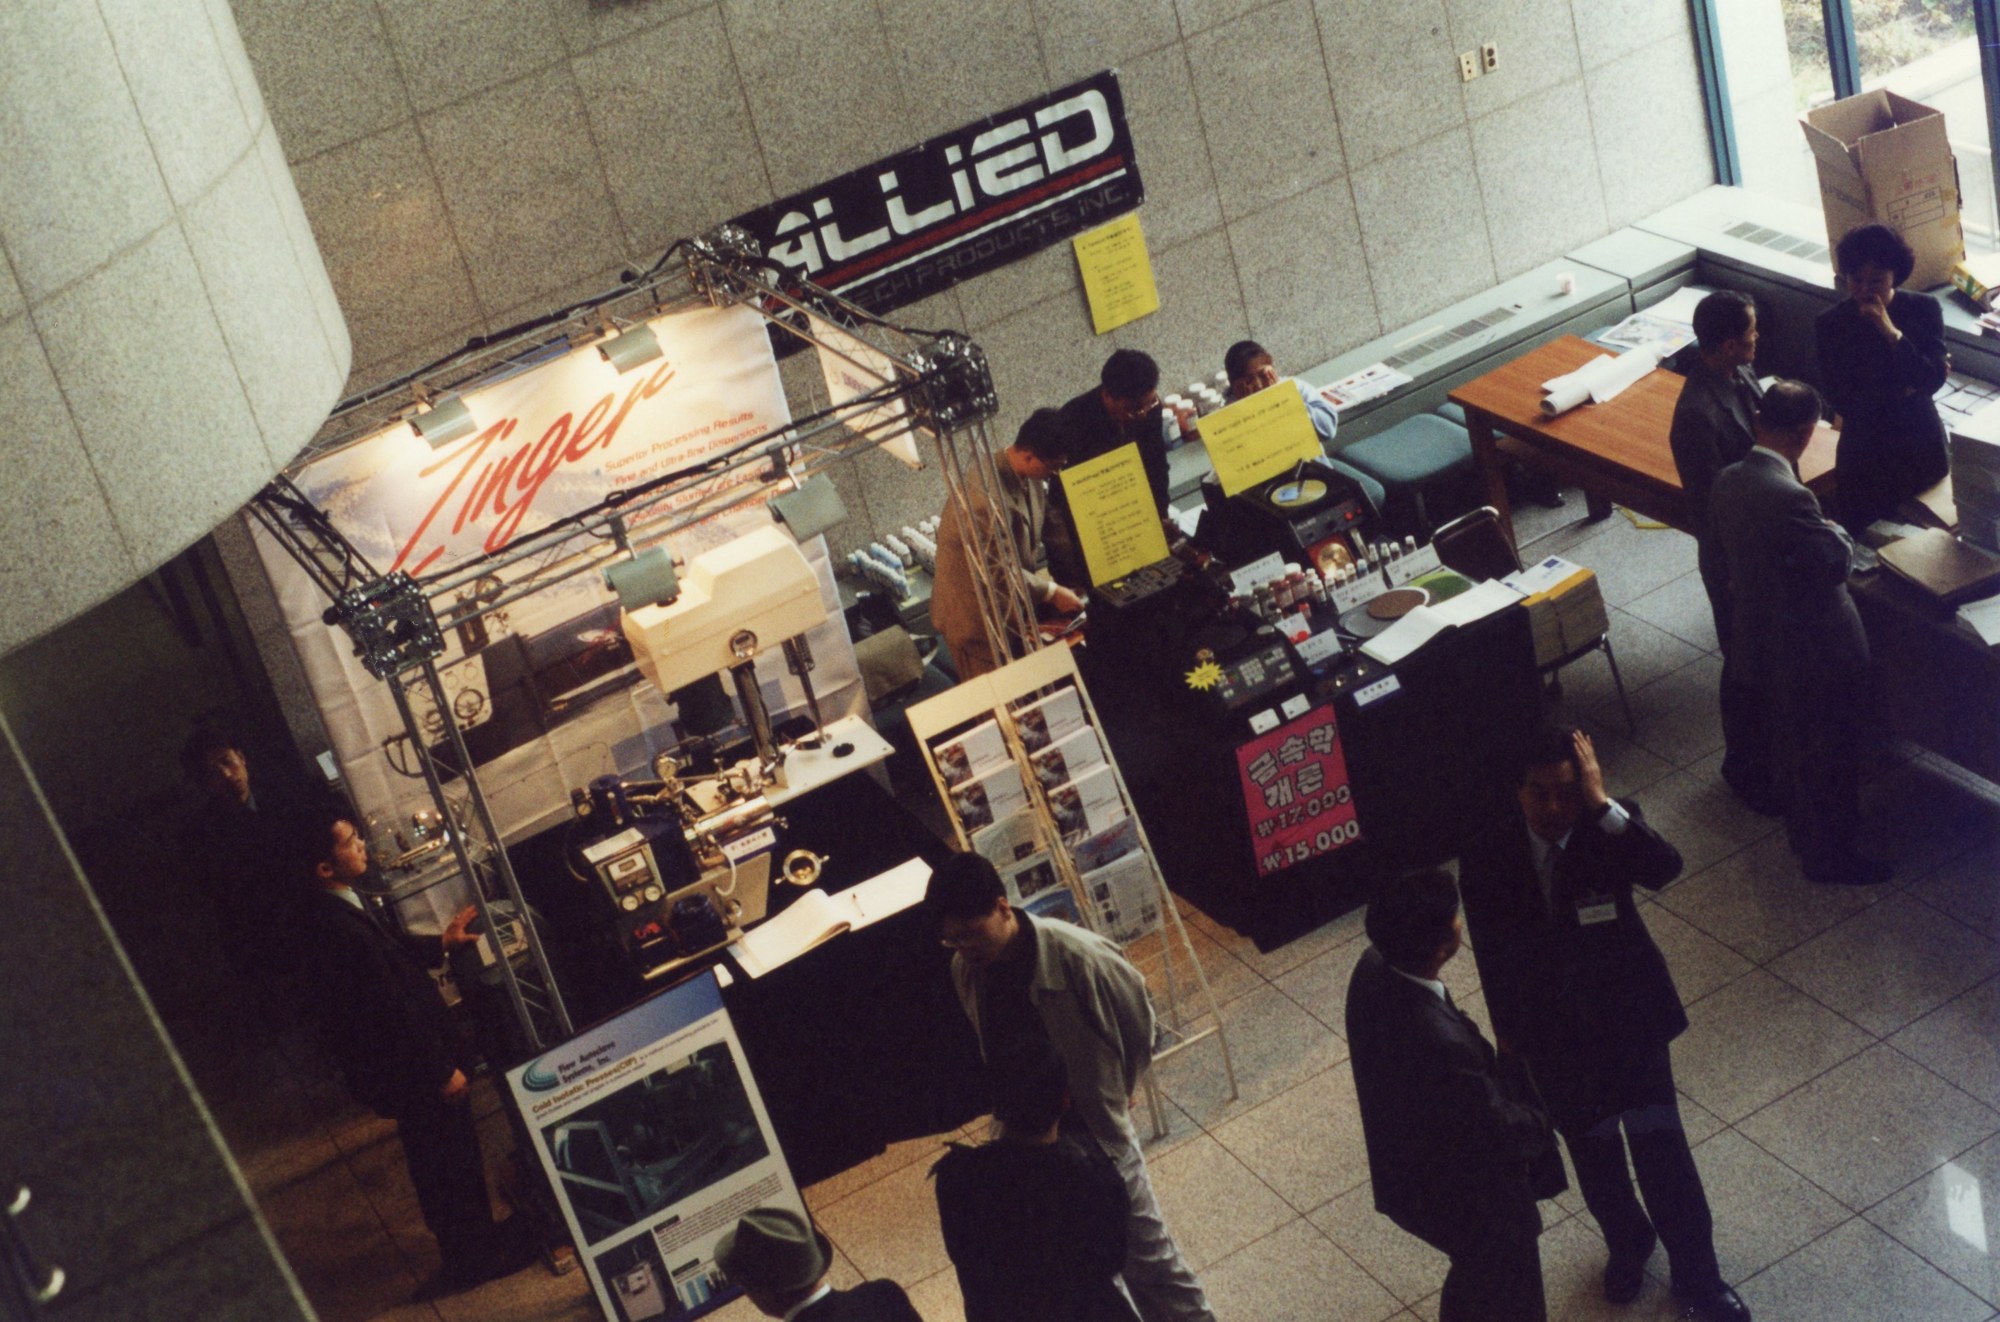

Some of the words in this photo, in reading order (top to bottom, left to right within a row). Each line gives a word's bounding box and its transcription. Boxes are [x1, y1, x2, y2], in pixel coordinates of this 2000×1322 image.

[767, 89, 1115, 288] ALLIED
[390, 362, 676, 577] Zinger
[605, 448, 648, 472] Superior
[651, 424, 710, 453] Processing
[713, 411, 754, 430] Results
[639, 462, 658, 478] and
[660, 446, 705, 472] Ultra-fine
[708, 423, 768, 451] Dispersions
[532, 1098, 553, 1114] Cold
